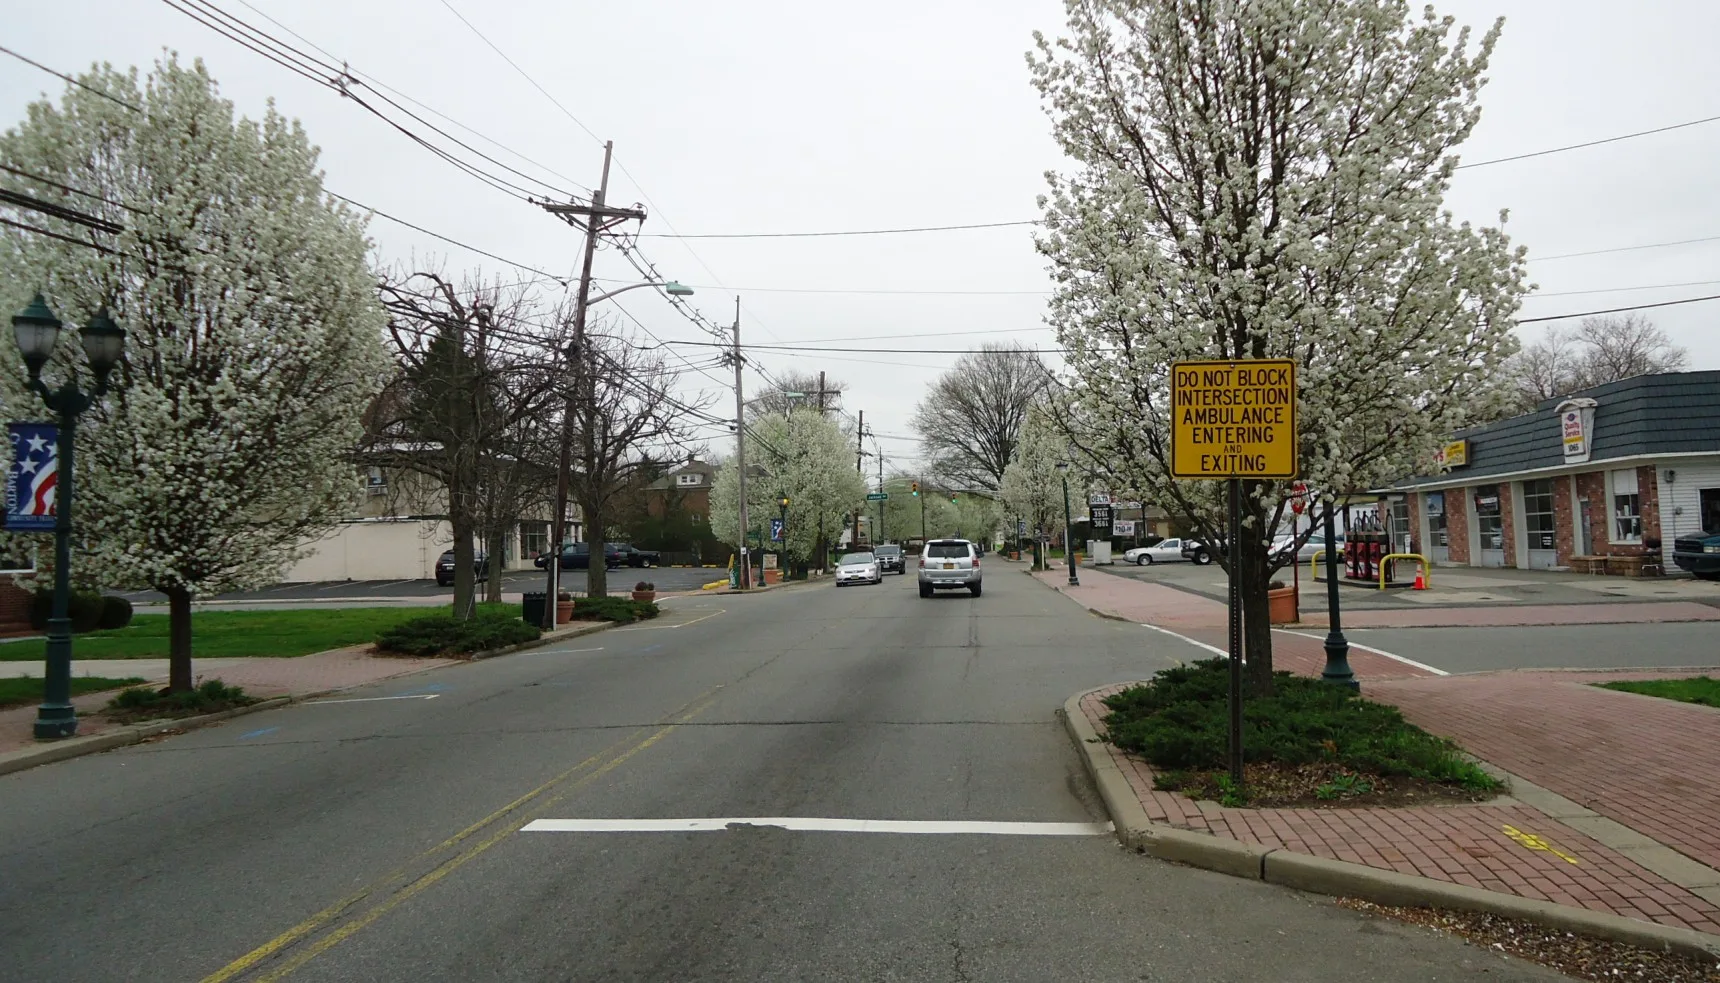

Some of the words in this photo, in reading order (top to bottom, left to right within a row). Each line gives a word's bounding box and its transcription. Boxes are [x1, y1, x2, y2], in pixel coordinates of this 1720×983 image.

[1178, 371, 1198, 388] DO
[1203, 370, 1233, 387] NOT
[1238, 368, 1288, 386] BLOCK
[1178, 388, 1289, 406] INTERSECTION
[1182, 407, 1284, 425] AMBULANCE
[1192, 426, 1274, 444] ENTERING
[1223, 444, 1242, 454] AND
[1201, 454, 1266, 472] EXITING
[8, 471, 19, 515] BARTON
[1091, 495, 1109, 503] DELTA
